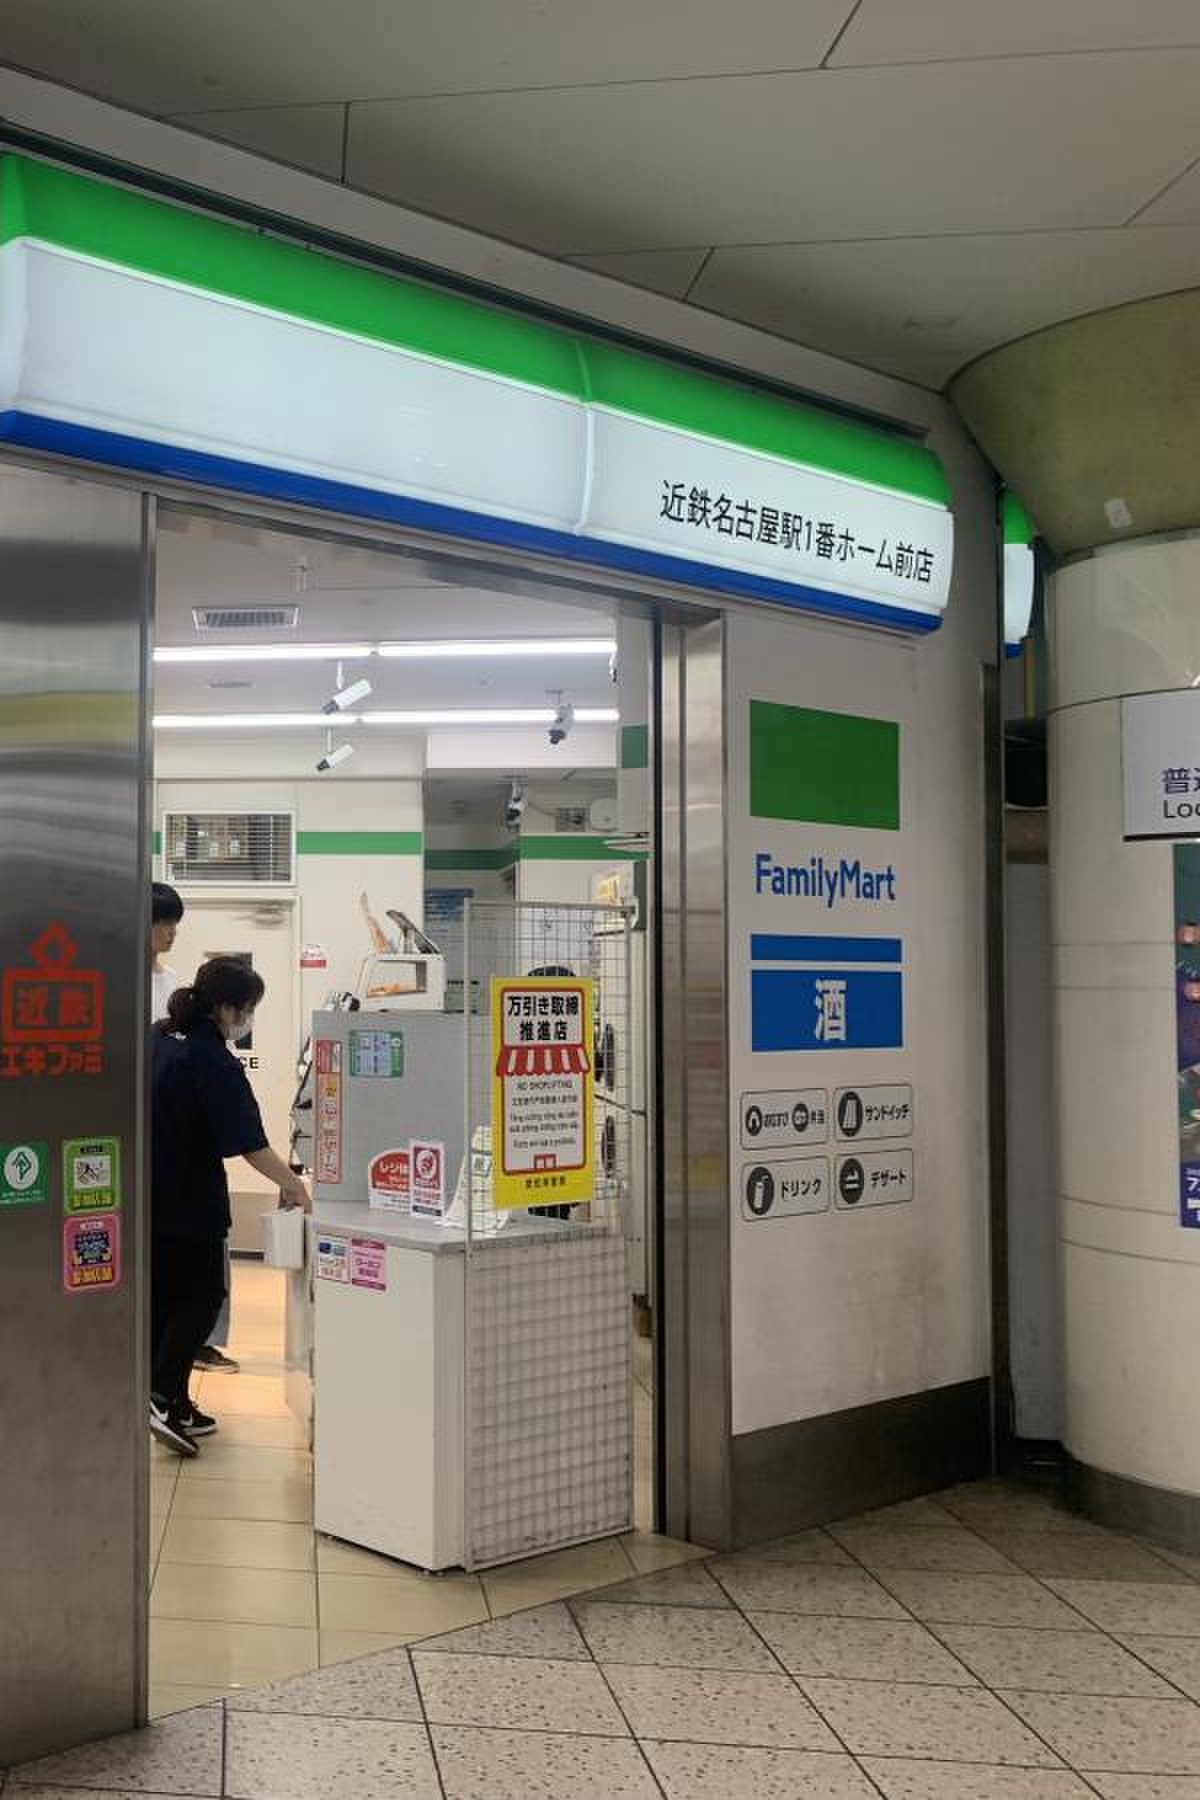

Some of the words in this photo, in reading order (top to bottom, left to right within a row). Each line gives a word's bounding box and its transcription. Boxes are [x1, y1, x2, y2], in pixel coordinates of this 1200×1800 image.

[659, 480, 935, 584] 近鉄名古屋駅1番ホーム前店
[755, 853, 896, 907] FamilyMart
[814, 978, 847, 1041] 酒
[519, 1020, 568, 1041] 推進店
[865, 1103, 911, 1122] サンドイッチ
[781, 1178, 822, 1199] ドリンク
[870, 1168, 908, 1188] デザート
